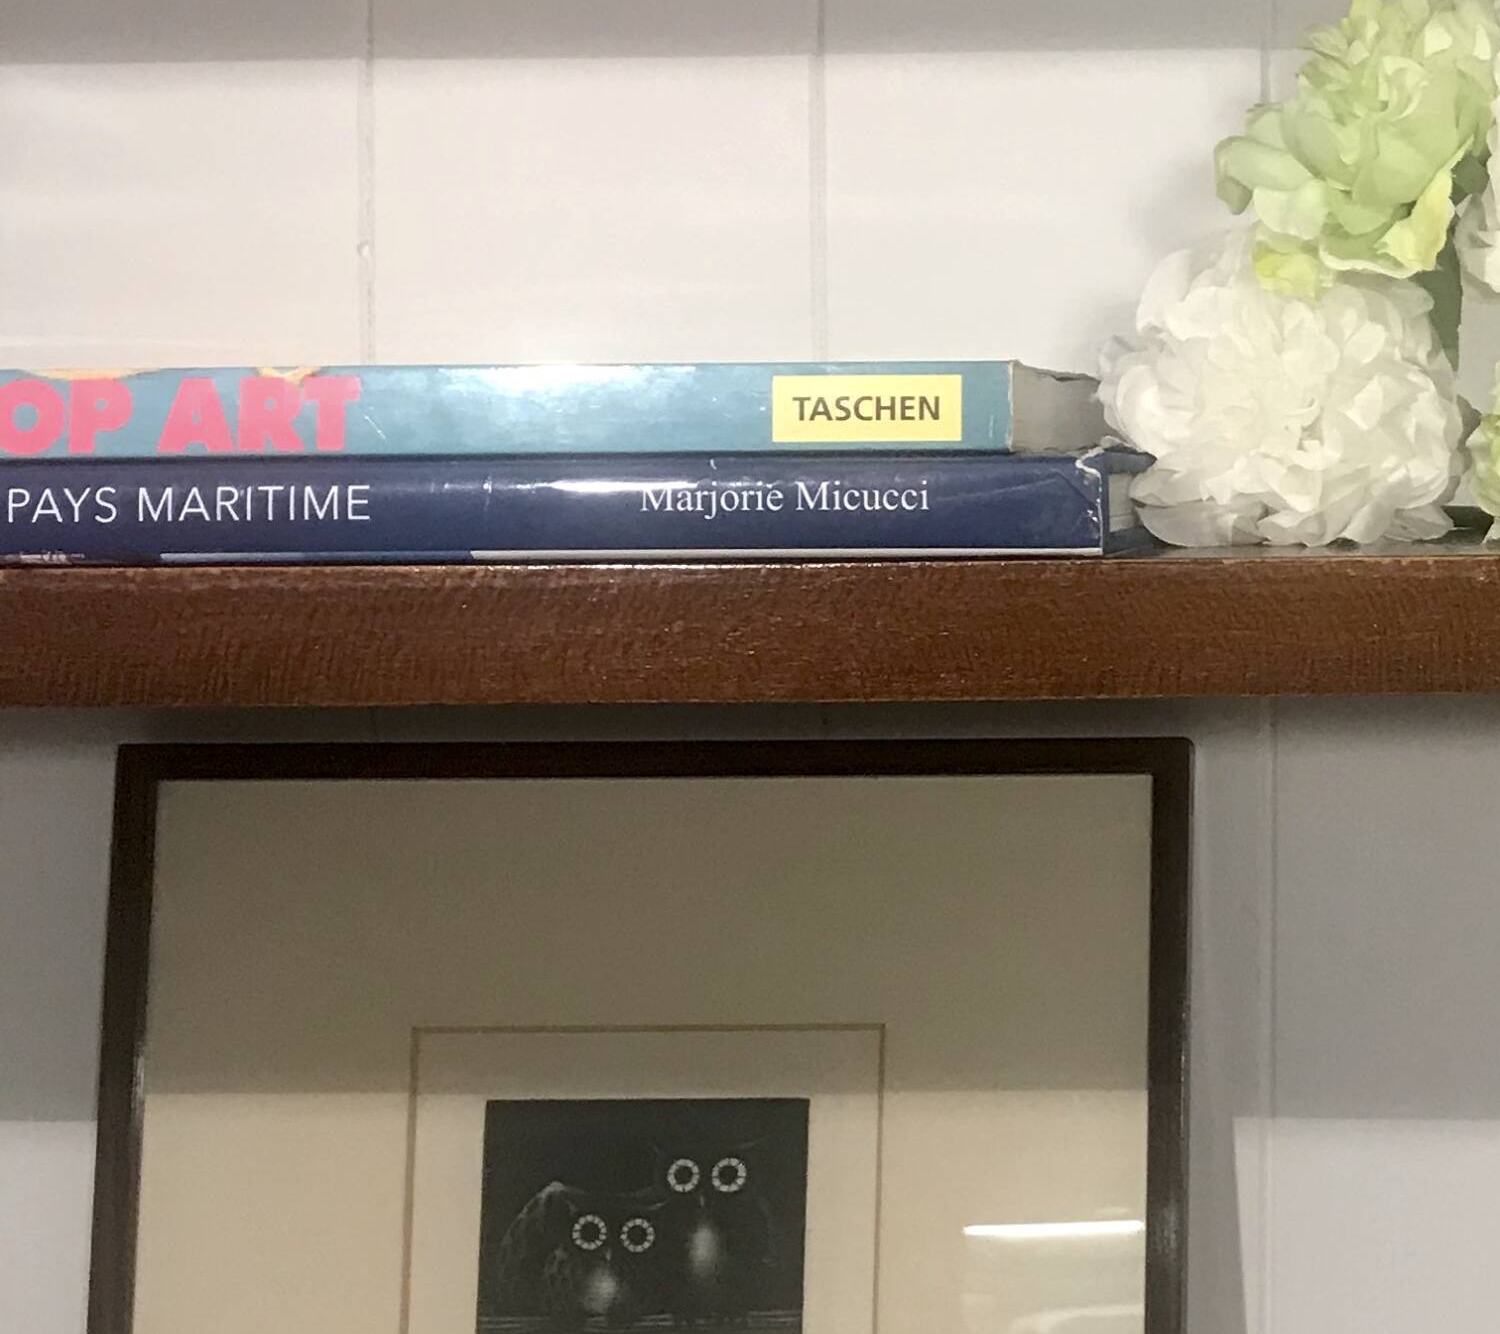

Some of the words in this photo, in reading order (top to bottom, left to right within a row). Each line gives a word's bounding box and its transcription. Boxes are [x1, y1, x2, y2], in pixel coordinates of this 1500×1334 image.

[157, 376, 362, 453] ART
[792, 395, 941, 422] TASCHEN
[7, 486, 118, 524] PAYS
[138, 484, 372, 523] MARITIME
[640, 482, 784, 521] Marjorie
[796, 479, 930, 512] Micucci
